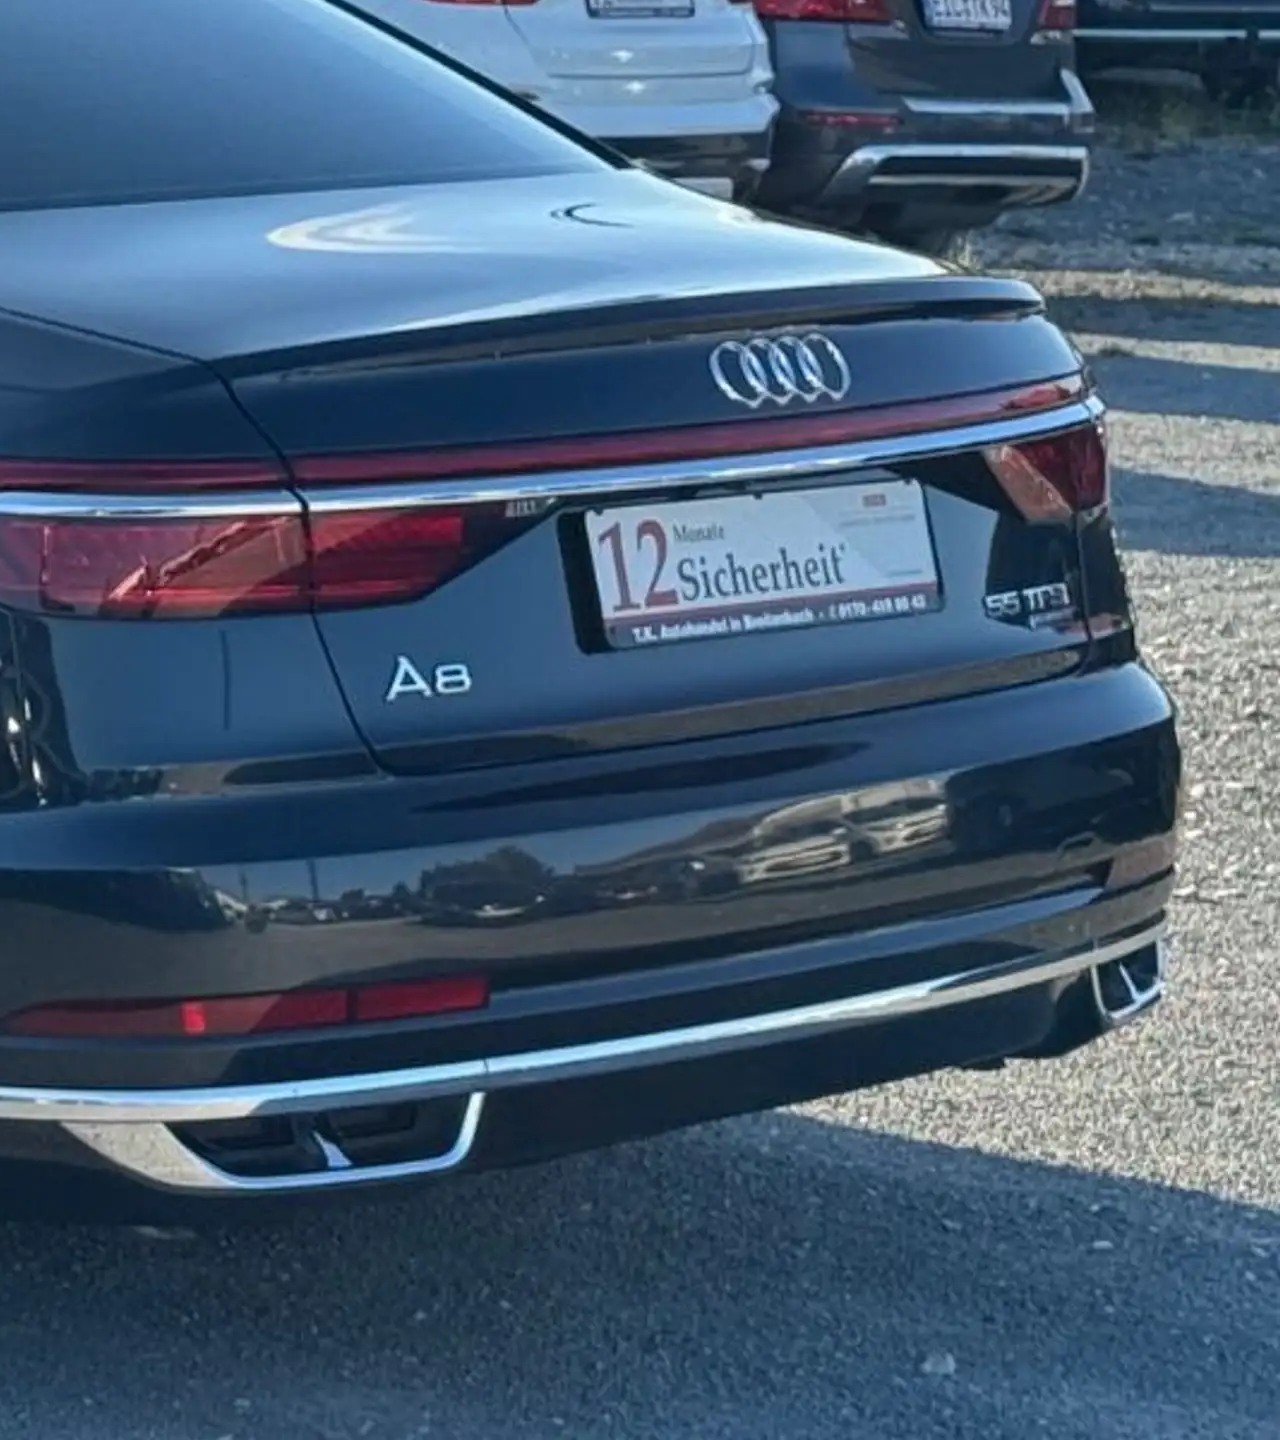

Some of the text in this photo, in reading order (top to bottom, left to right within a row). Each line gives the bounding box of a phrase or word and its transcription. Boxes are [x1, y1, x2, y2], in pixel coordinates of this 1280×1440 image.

[598, 518, 679, 612] 12
[985, 590, 1020, 617] 55
[386, 654, 472, 701] A8
